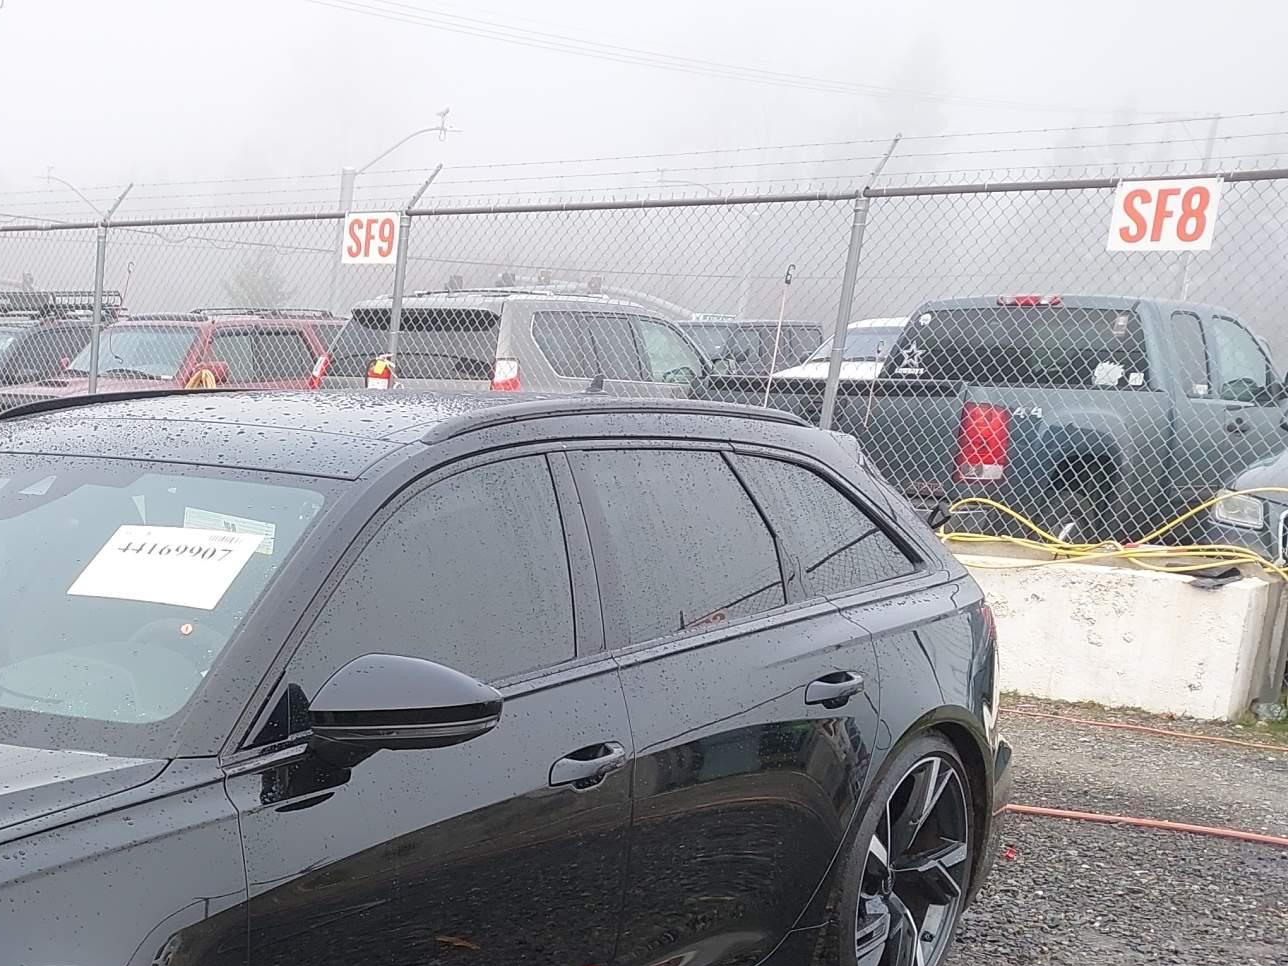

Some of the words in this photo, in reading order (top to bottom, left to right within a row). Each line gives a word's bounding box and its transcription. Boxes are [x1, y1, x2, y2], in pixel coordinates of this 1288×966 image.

[1119, 186, 1210, 243] SF8
[347, 218, 394, 258] SF9
[117, 541, 233, 562] 44169907
